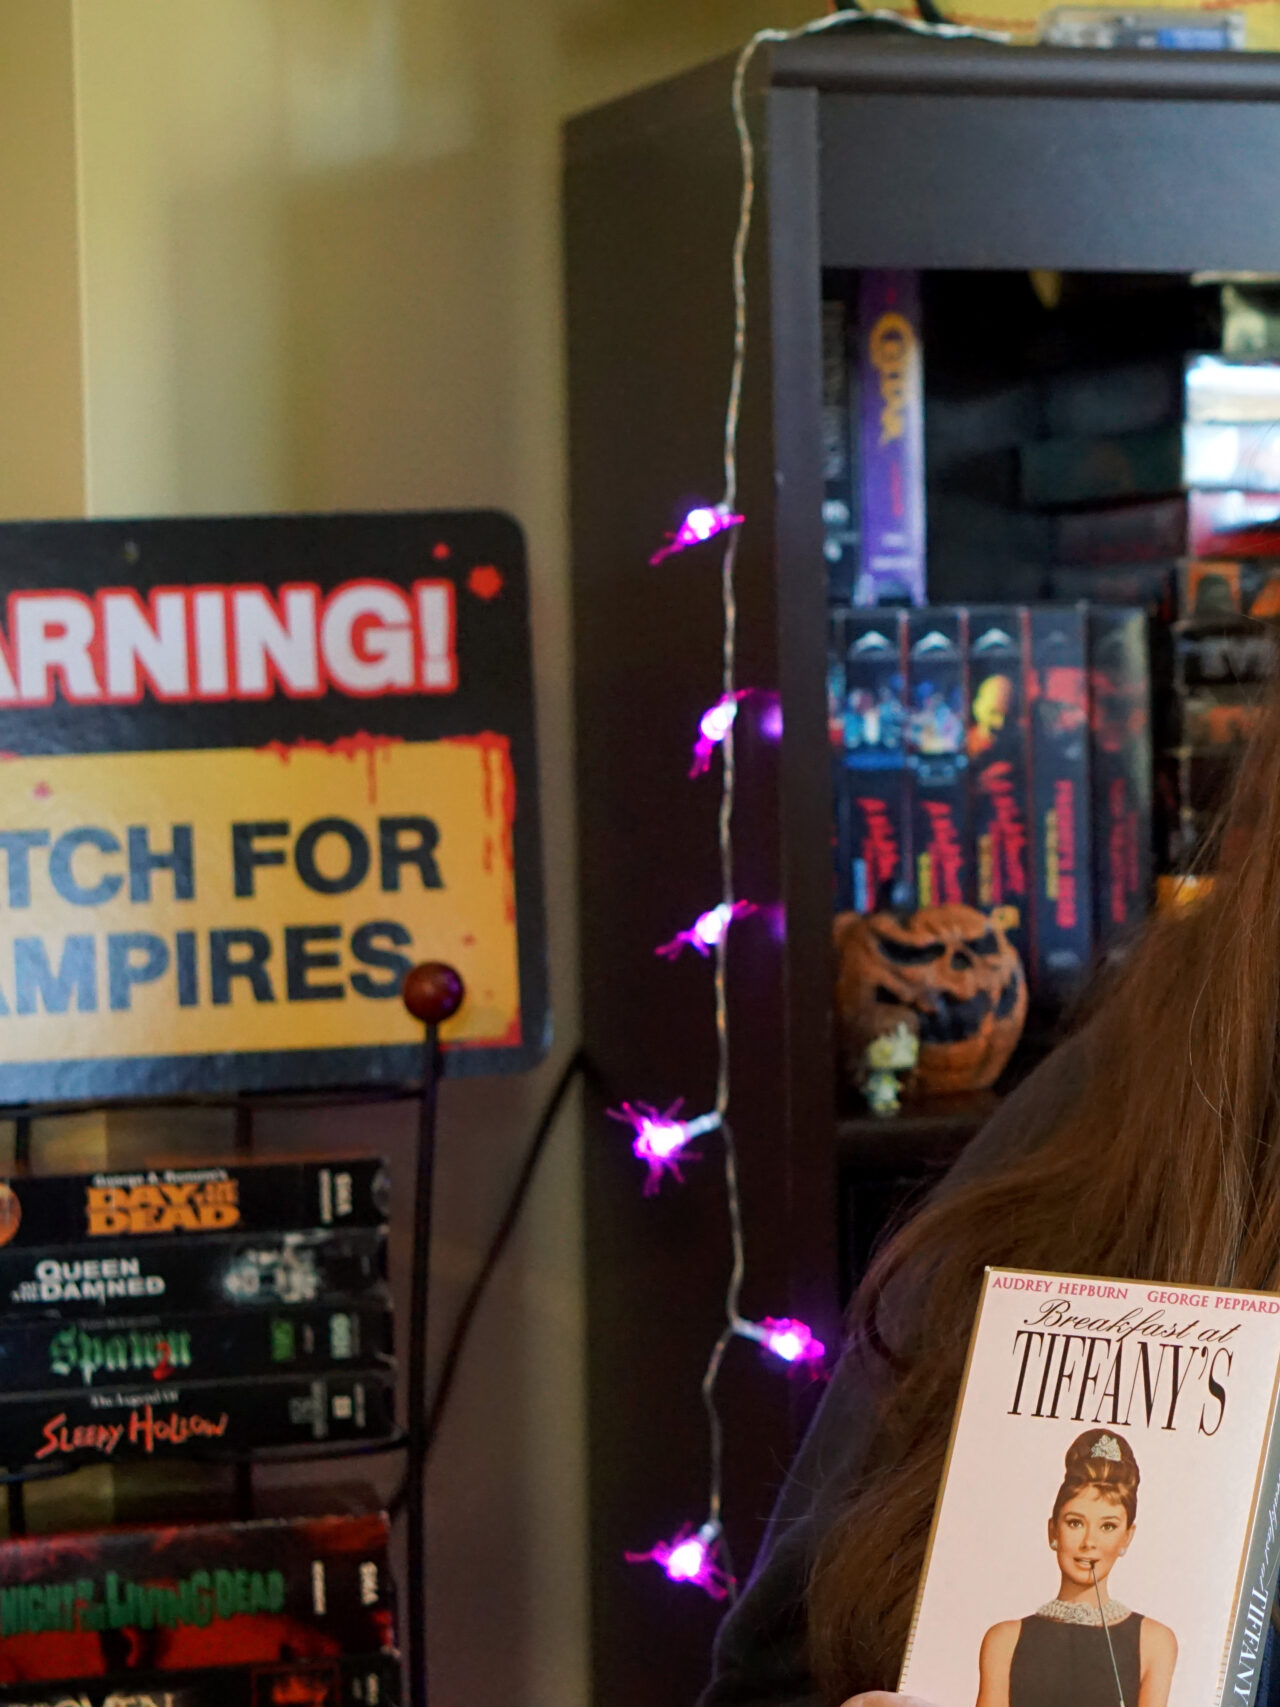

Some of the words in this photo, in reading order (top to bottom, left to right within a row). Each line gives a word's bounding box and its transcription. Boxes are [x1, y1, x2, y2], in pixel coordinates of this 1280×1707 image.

[0, 578, 458, 705] RNING!
[0, 823, 194, 907] TCH
[231, 816, 444, 897] FOR
[0, 920, 415, 1016] MPIRES
[87, 1183, 203, 1211] DAY
[88, 1203, 241, 1236] DEAD
[35, 1257, 140, 1284] QUEEN
[40, 1276, 166, 1304] DAMNED
[992, 1276, 1054, 1293] AUDREY
[1057, 1281, 1129, 1300] HEPBURN
[1146, 1290, 1210, 1308] GEORGE
[1213, 1296, 1280, 1315] PEPPARD
[1023, 1298, 1201, 1343] Breakfast
[1196, 1323, 1243, 1344] at
[1007, 1330, 1234, 1436] TIFFANY'S
